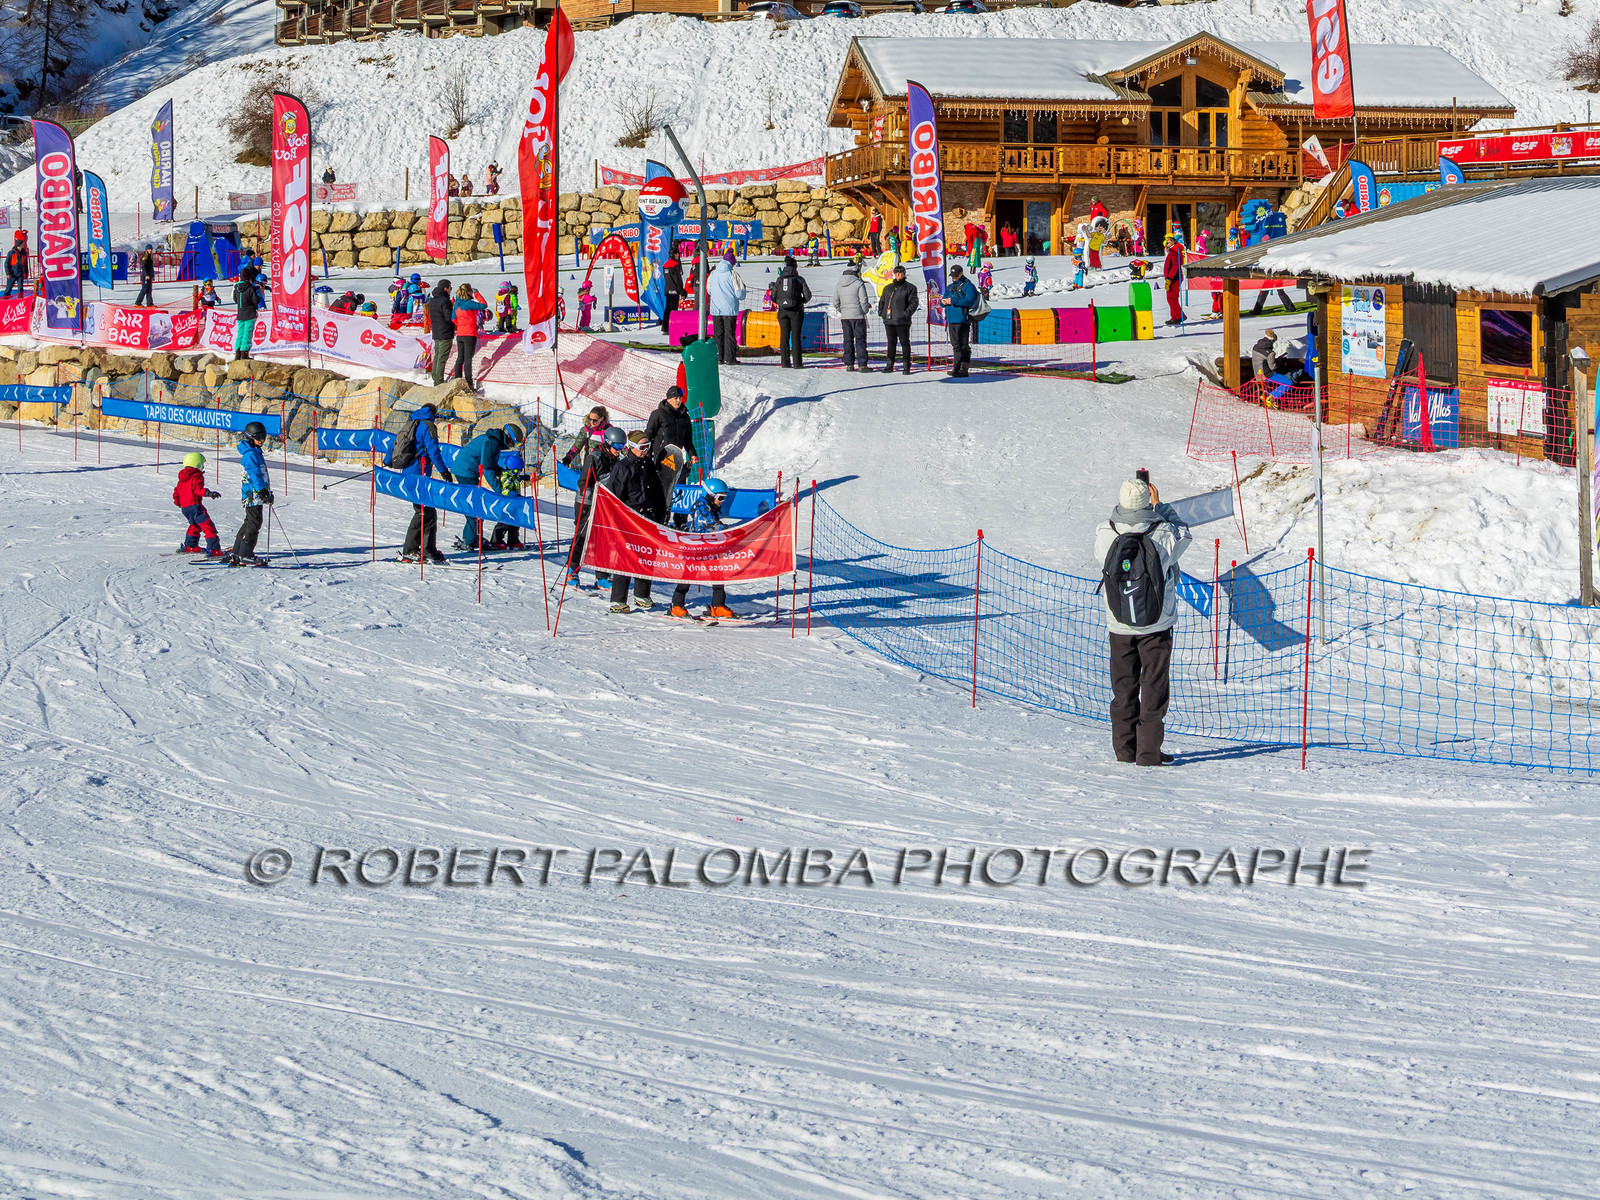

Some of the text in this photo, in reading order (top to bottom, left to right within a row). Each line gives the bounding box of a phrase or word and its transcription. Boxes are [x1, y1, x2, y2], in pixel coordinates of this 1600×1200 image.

[1586, 137, 1600, 146] es
[677, 225, 701, 235] HARIB
[113, 309, 143, 328] AIR
[108, 327, 141, 345] BAG
[143, 405, 232, 428] TAPIS DES CHAUVETS
